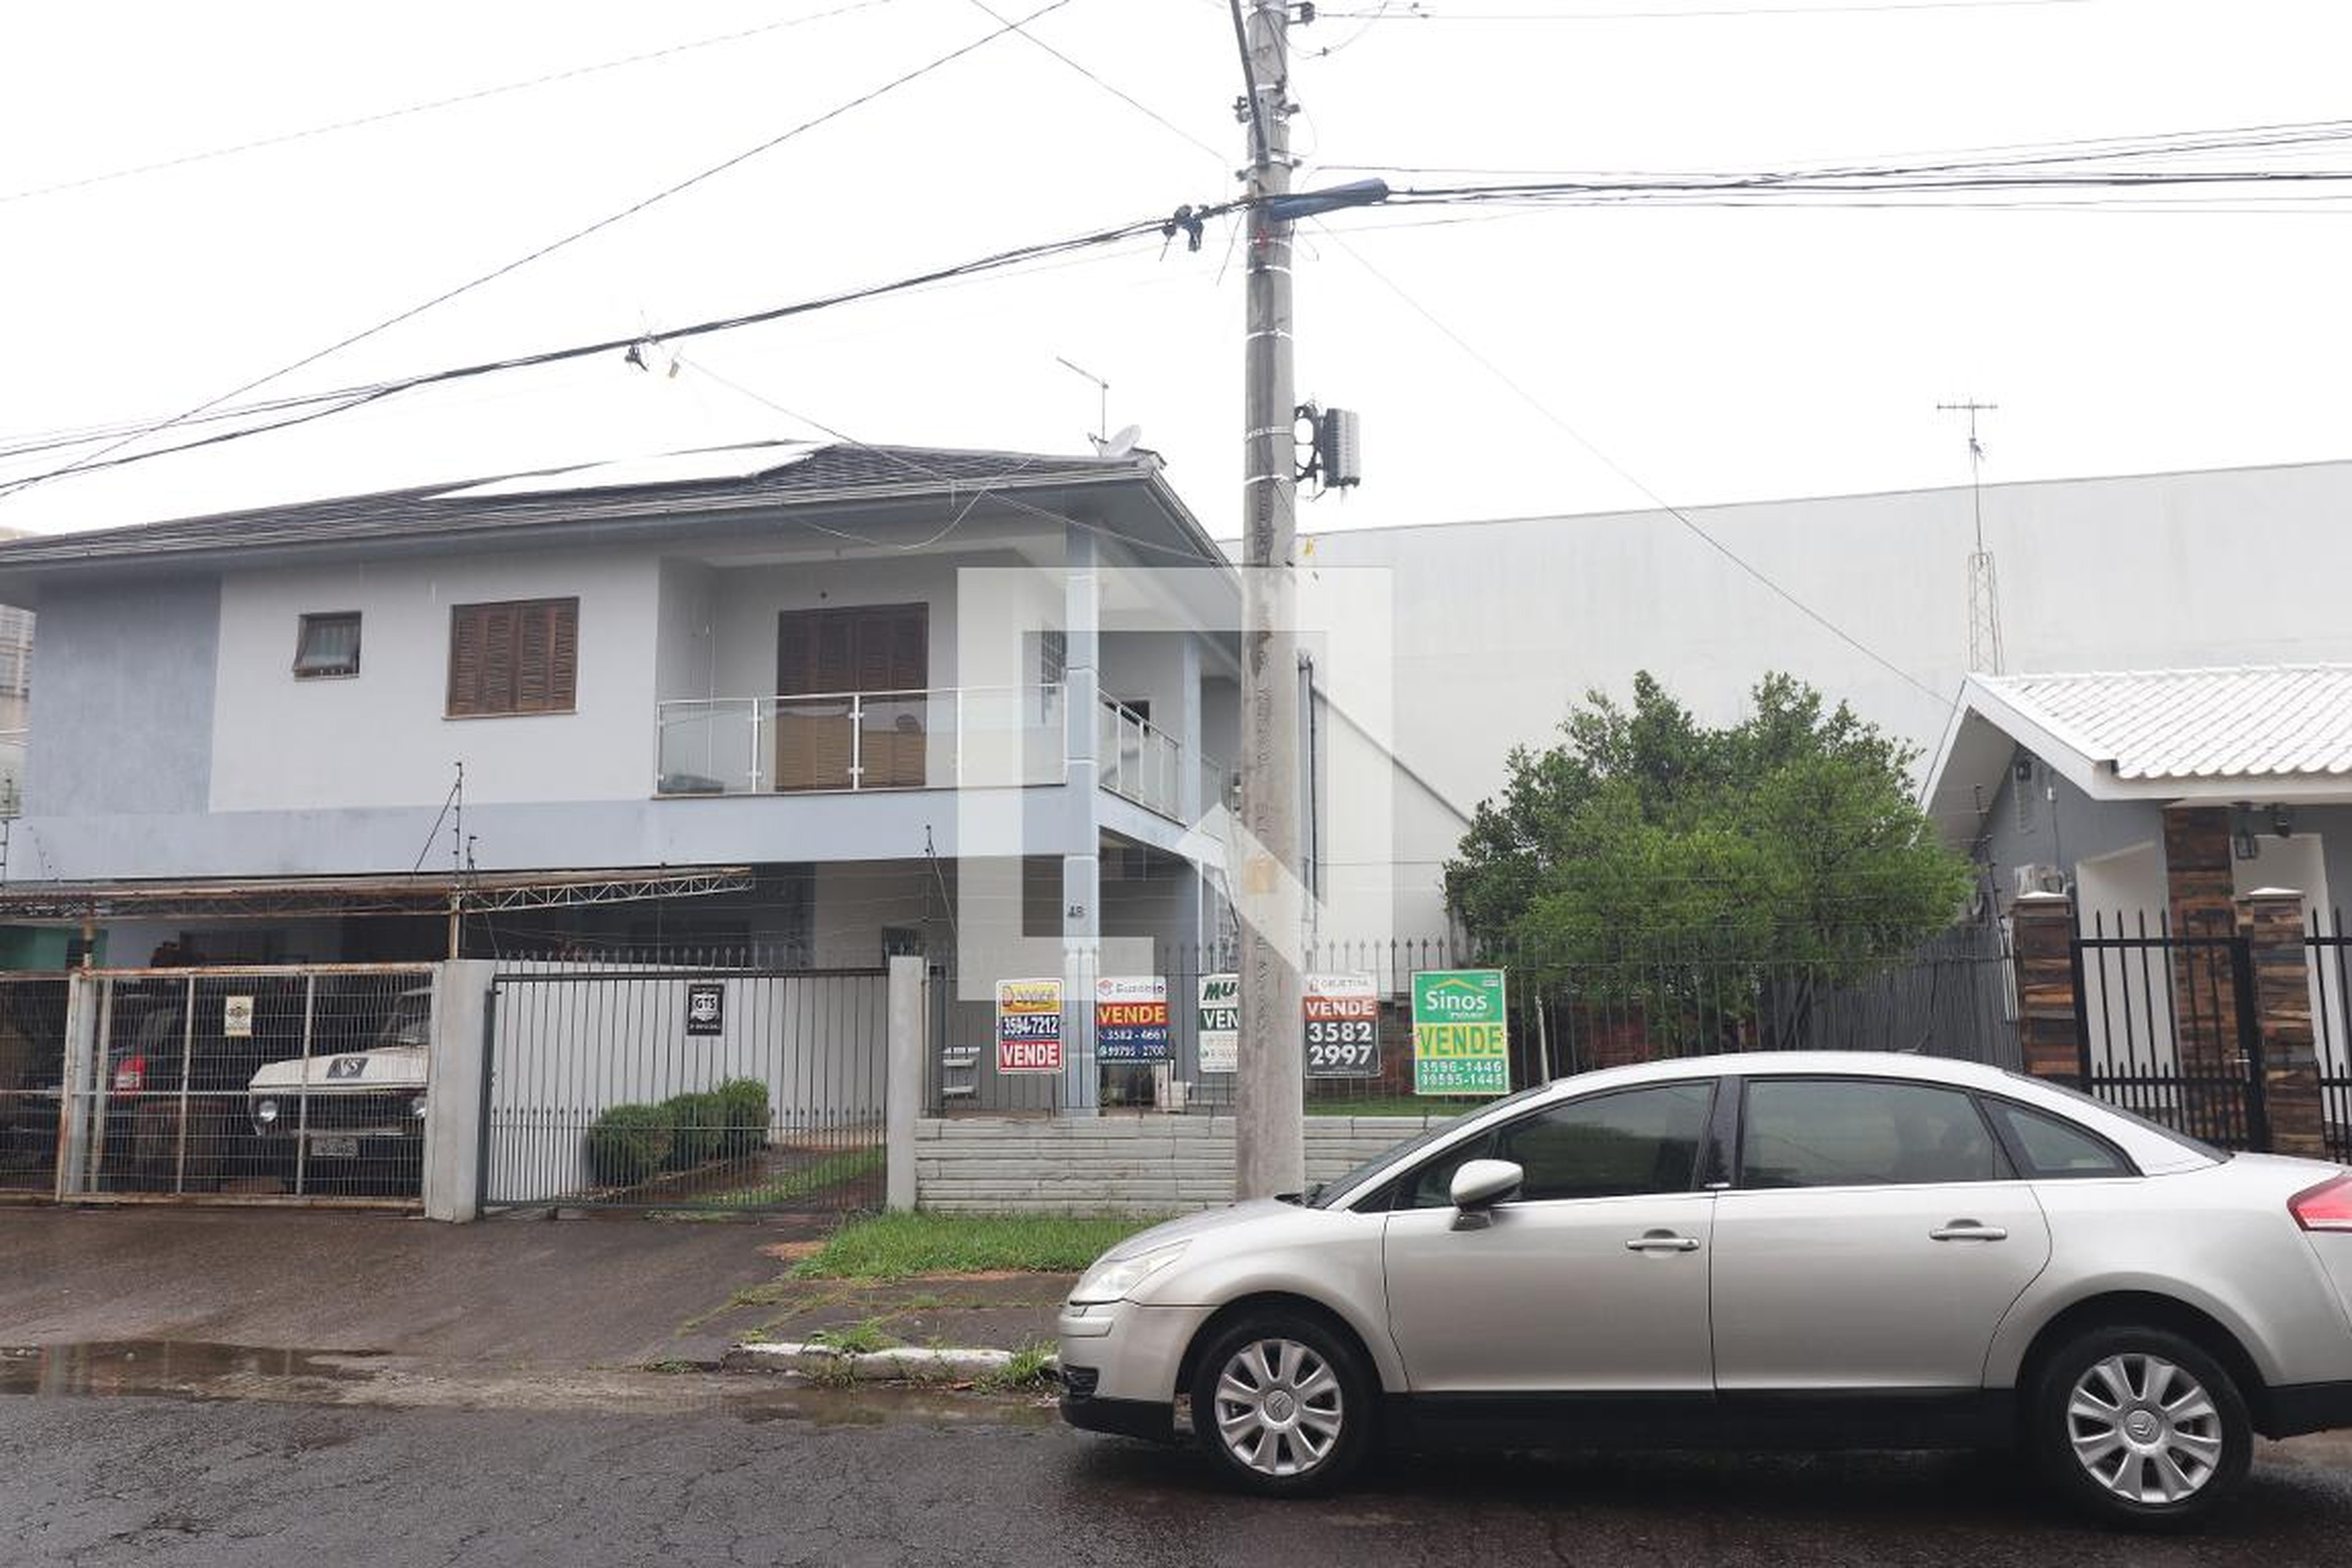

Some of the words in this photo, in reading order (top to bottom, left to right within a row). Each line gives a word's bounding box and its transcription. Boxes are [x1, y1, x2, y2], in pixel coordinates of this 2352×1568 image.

[1306, 1001, 1375, 1016] VENDE
[1426, 990, 1488, 1011] Sinos
[1099, 1005, 1166, 1023] VENDE
[1203, 1011, 1238, 1030] VEN
[1308, 1022, 1373, 1042] 3582
[1417, 1025, 1504, 1055] VENDE
[1003, 1043, 1059, 1066] VENDE
[1309, 1044, 1373, 1065] 2997
